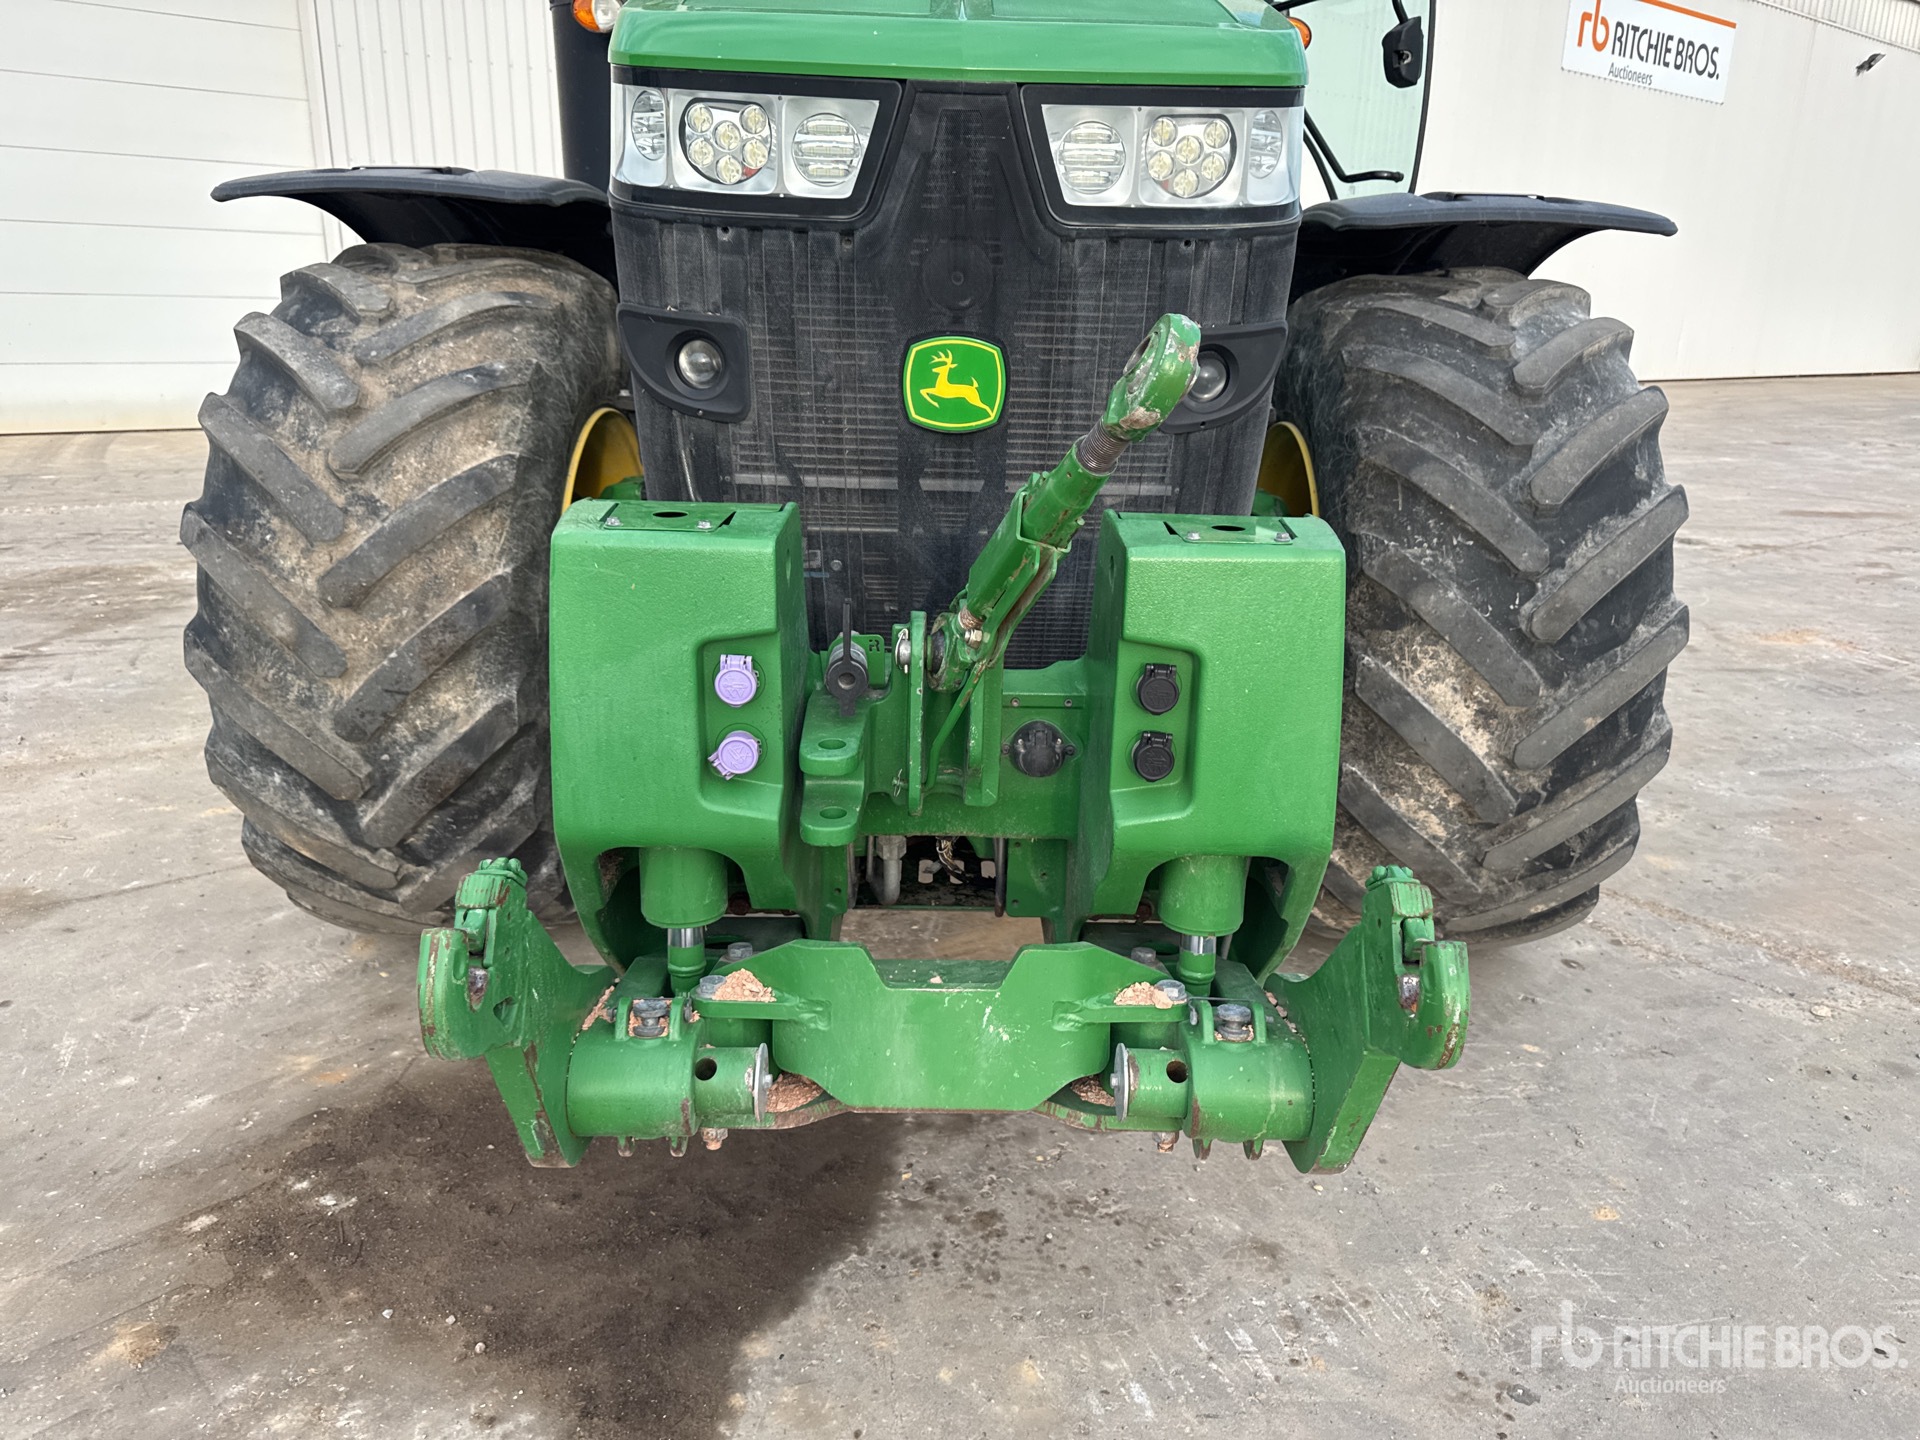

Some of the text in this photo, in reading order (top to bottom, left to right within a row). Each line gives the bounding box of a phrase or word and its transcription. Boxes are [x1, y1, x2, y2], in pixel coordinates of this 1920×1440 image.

[1611, 21, 1674, 68] RITCHIE
[1674, 37, 1720, 80] BROS.
[1608, 62, 1653, 86] Auctioneers
